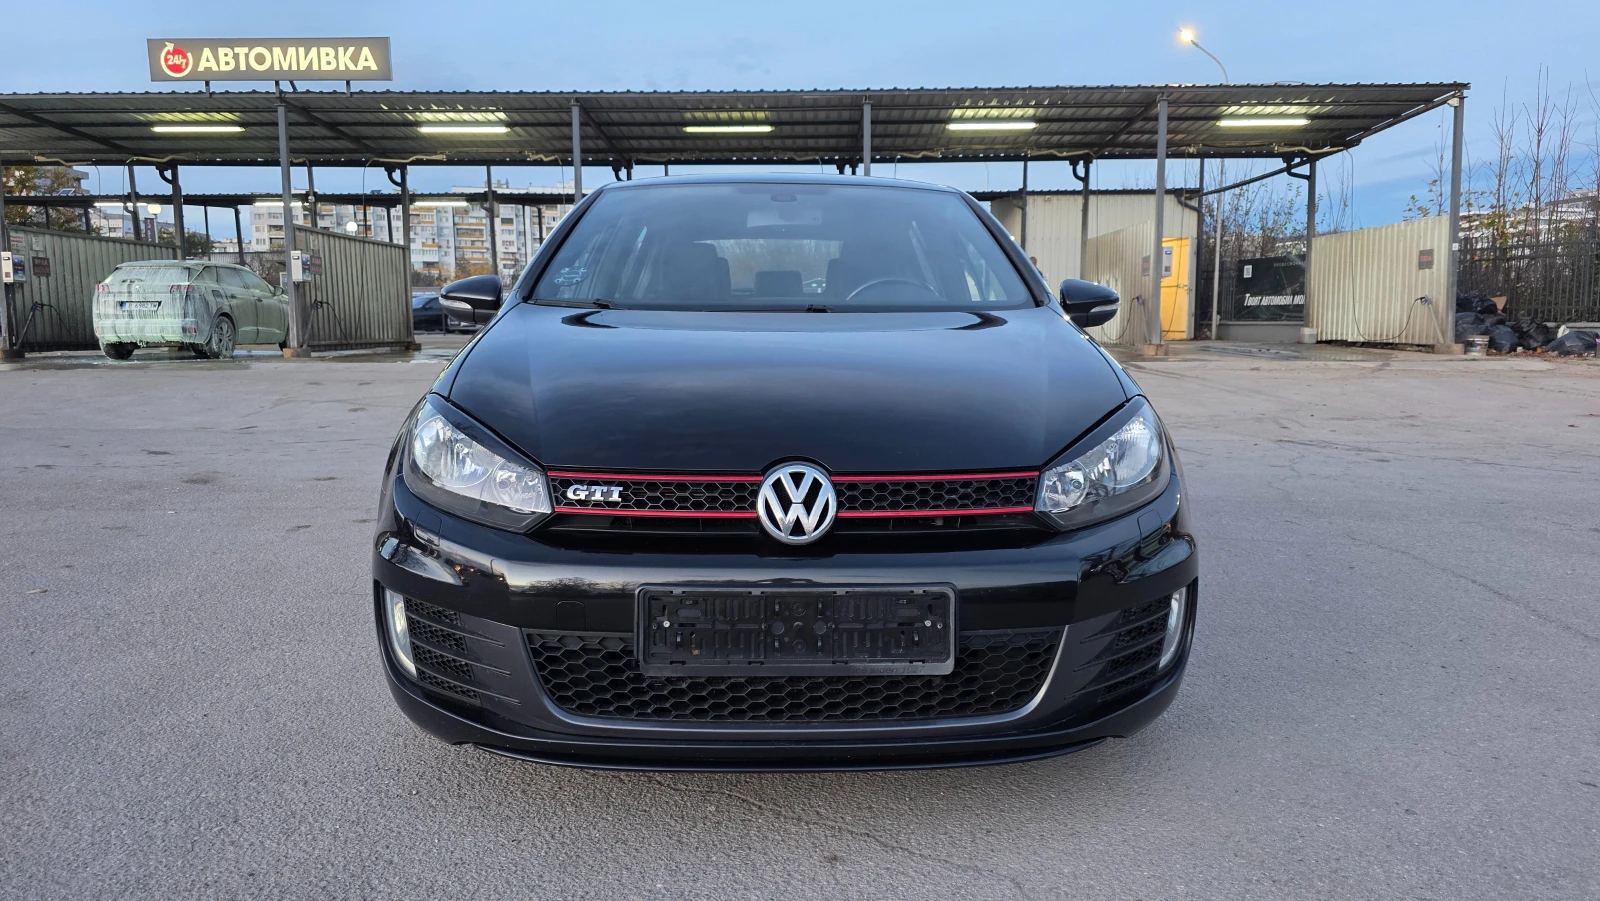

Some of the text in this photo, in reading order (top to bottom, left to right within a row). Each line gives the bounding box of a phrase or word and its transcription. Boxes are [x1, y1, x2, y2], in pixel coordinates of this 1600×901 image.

[166, 54, 187, 69] 24/7
[198, 47, 378, 71] АВТОМИВКА
[566, 484, 624, 502] GTI
[760, 465, 835, 542] VW
